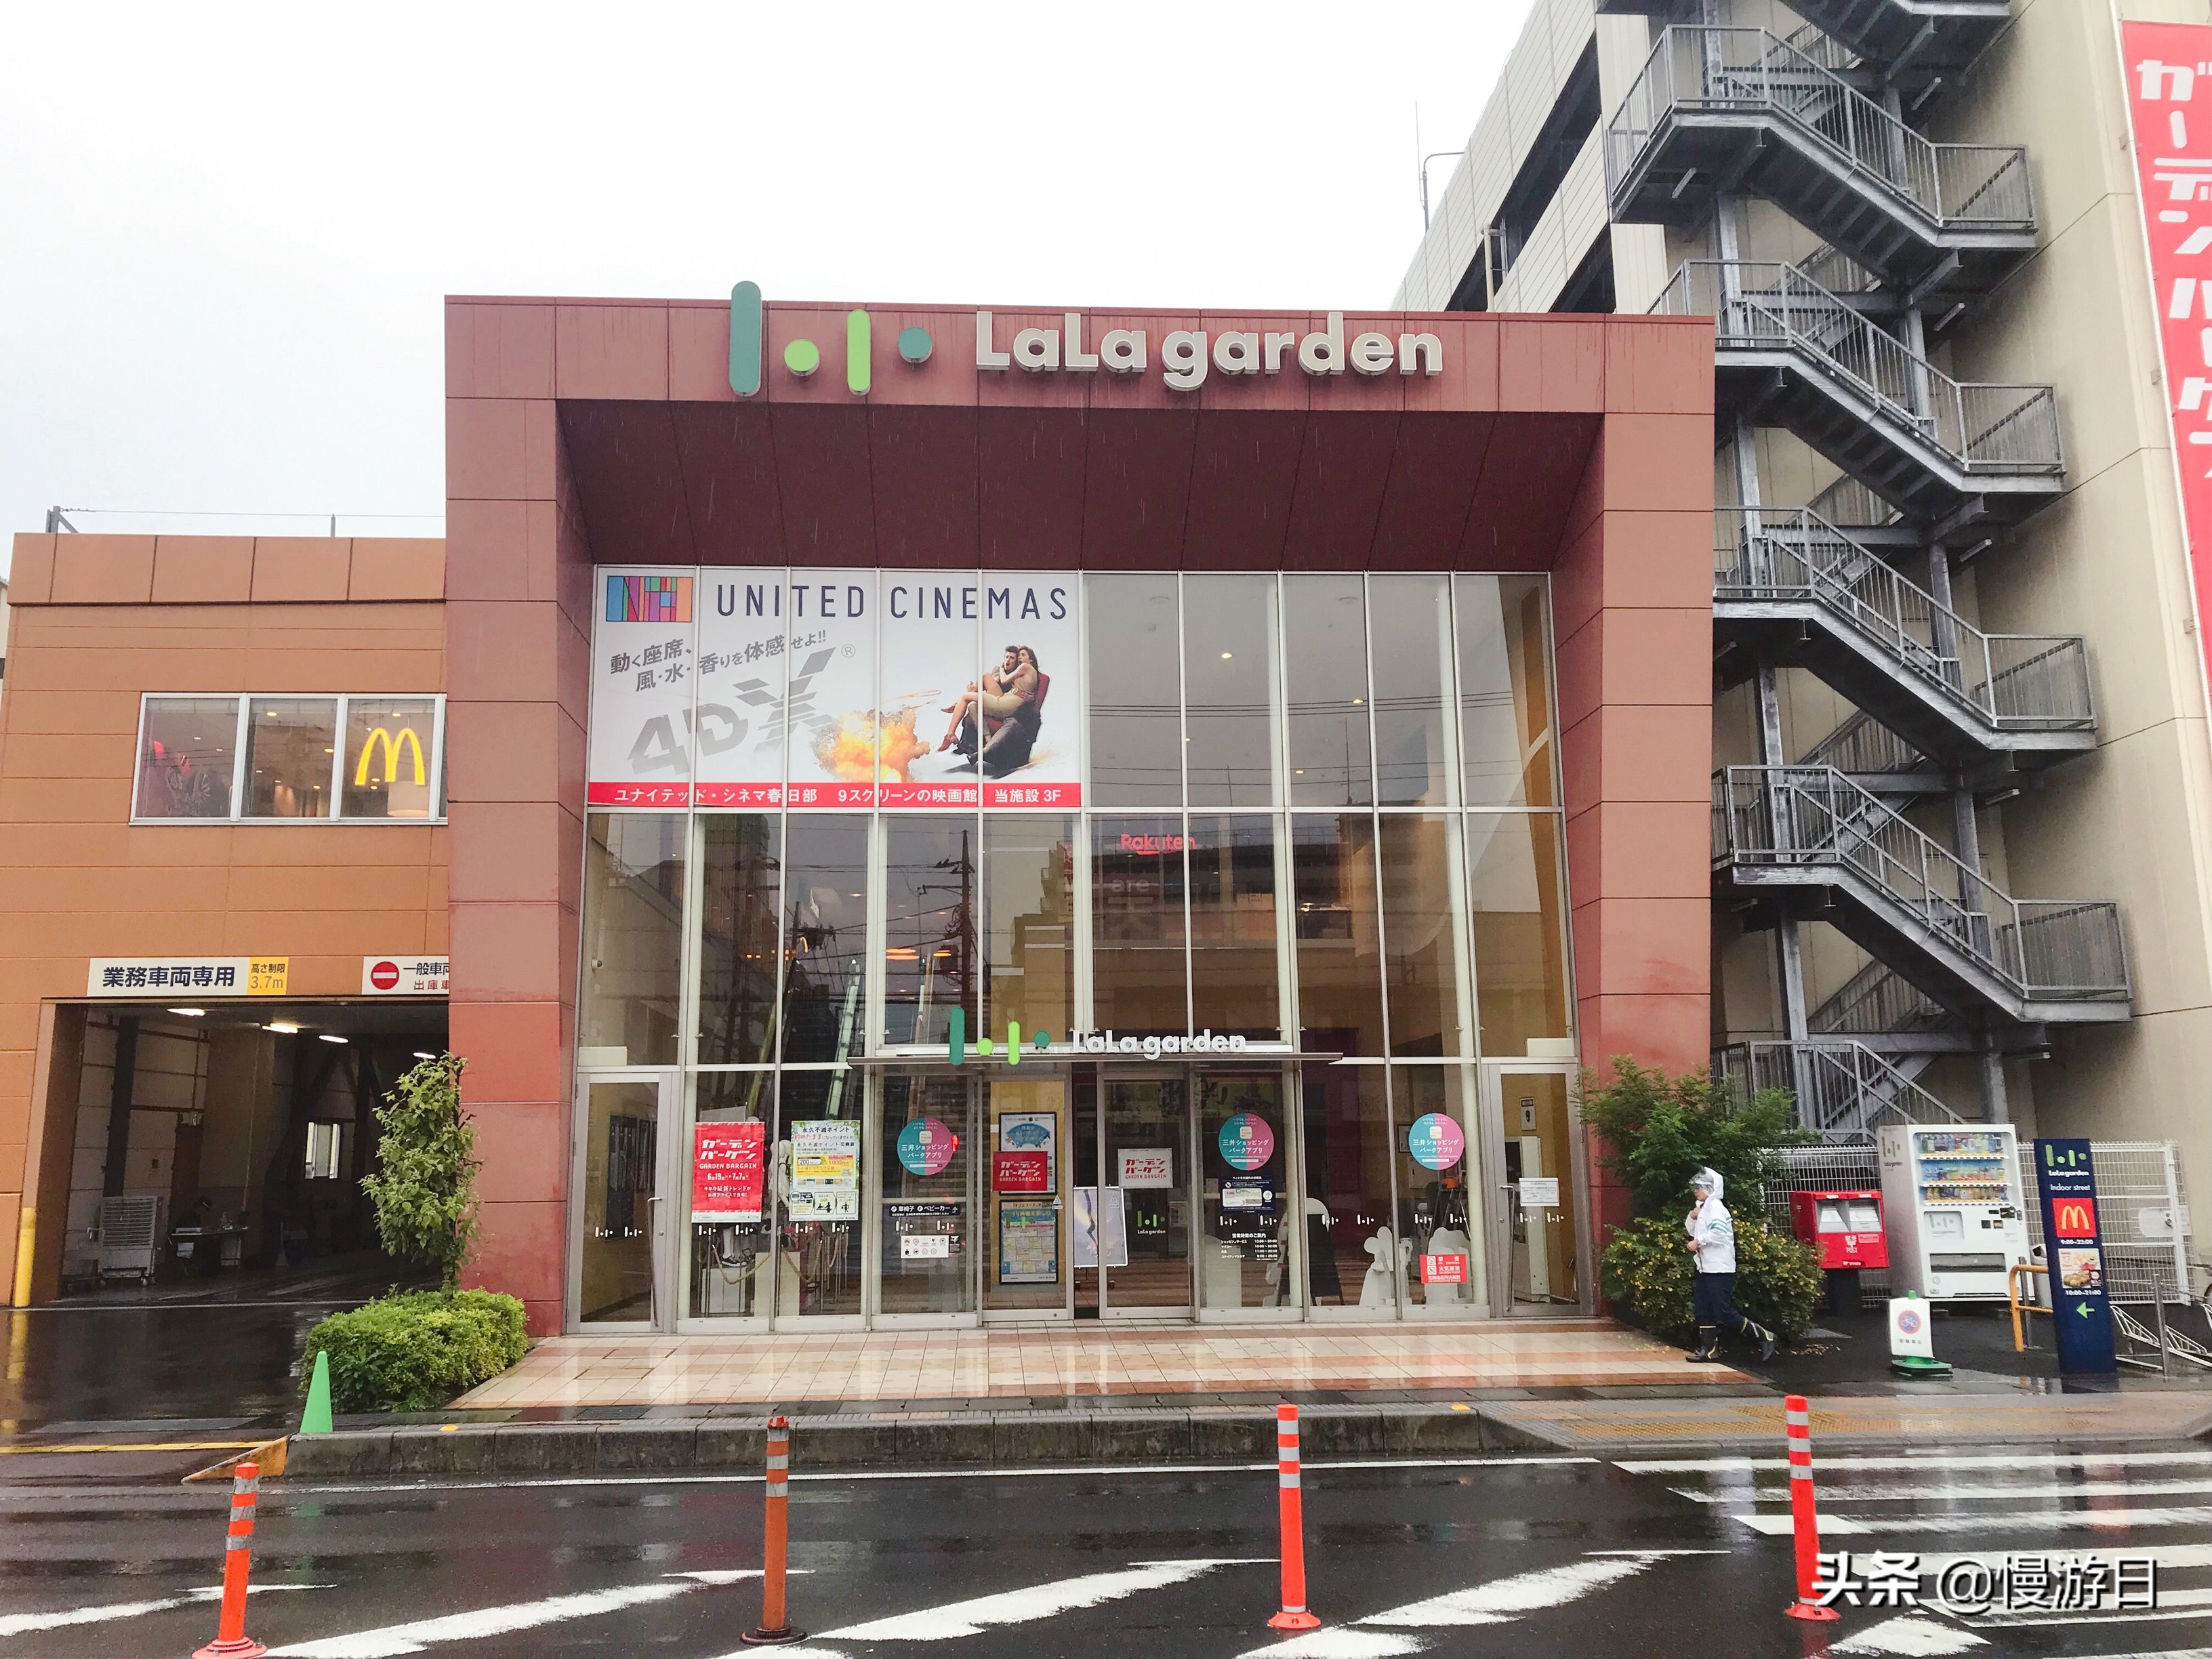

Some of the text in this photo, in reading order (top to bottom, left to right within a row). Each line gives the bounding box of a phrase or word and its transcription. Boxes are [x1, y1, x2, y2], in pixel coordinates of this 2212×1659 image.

[977, 310, 1443, 392] LaLa garden
[717, 583, 1067, 620] UNITED CINEMAS
[610, 638, 693, 674] 動く座席、
[838, 788, 977, 804] 9スクリーンの映画館
[1120, 833, 1195, 850] Rakuten
[102, 966, 235, 987] 業務車両専用
[250, 964, 285, 973] 高さ制限
[250, 976, 284, 989] 3.7m
[1073, 1029, 1246, 1060] LaLa garden
[701, 1139, 758, 1149] ガーデン
[700, 1150, 757, 1160] バーゲン
